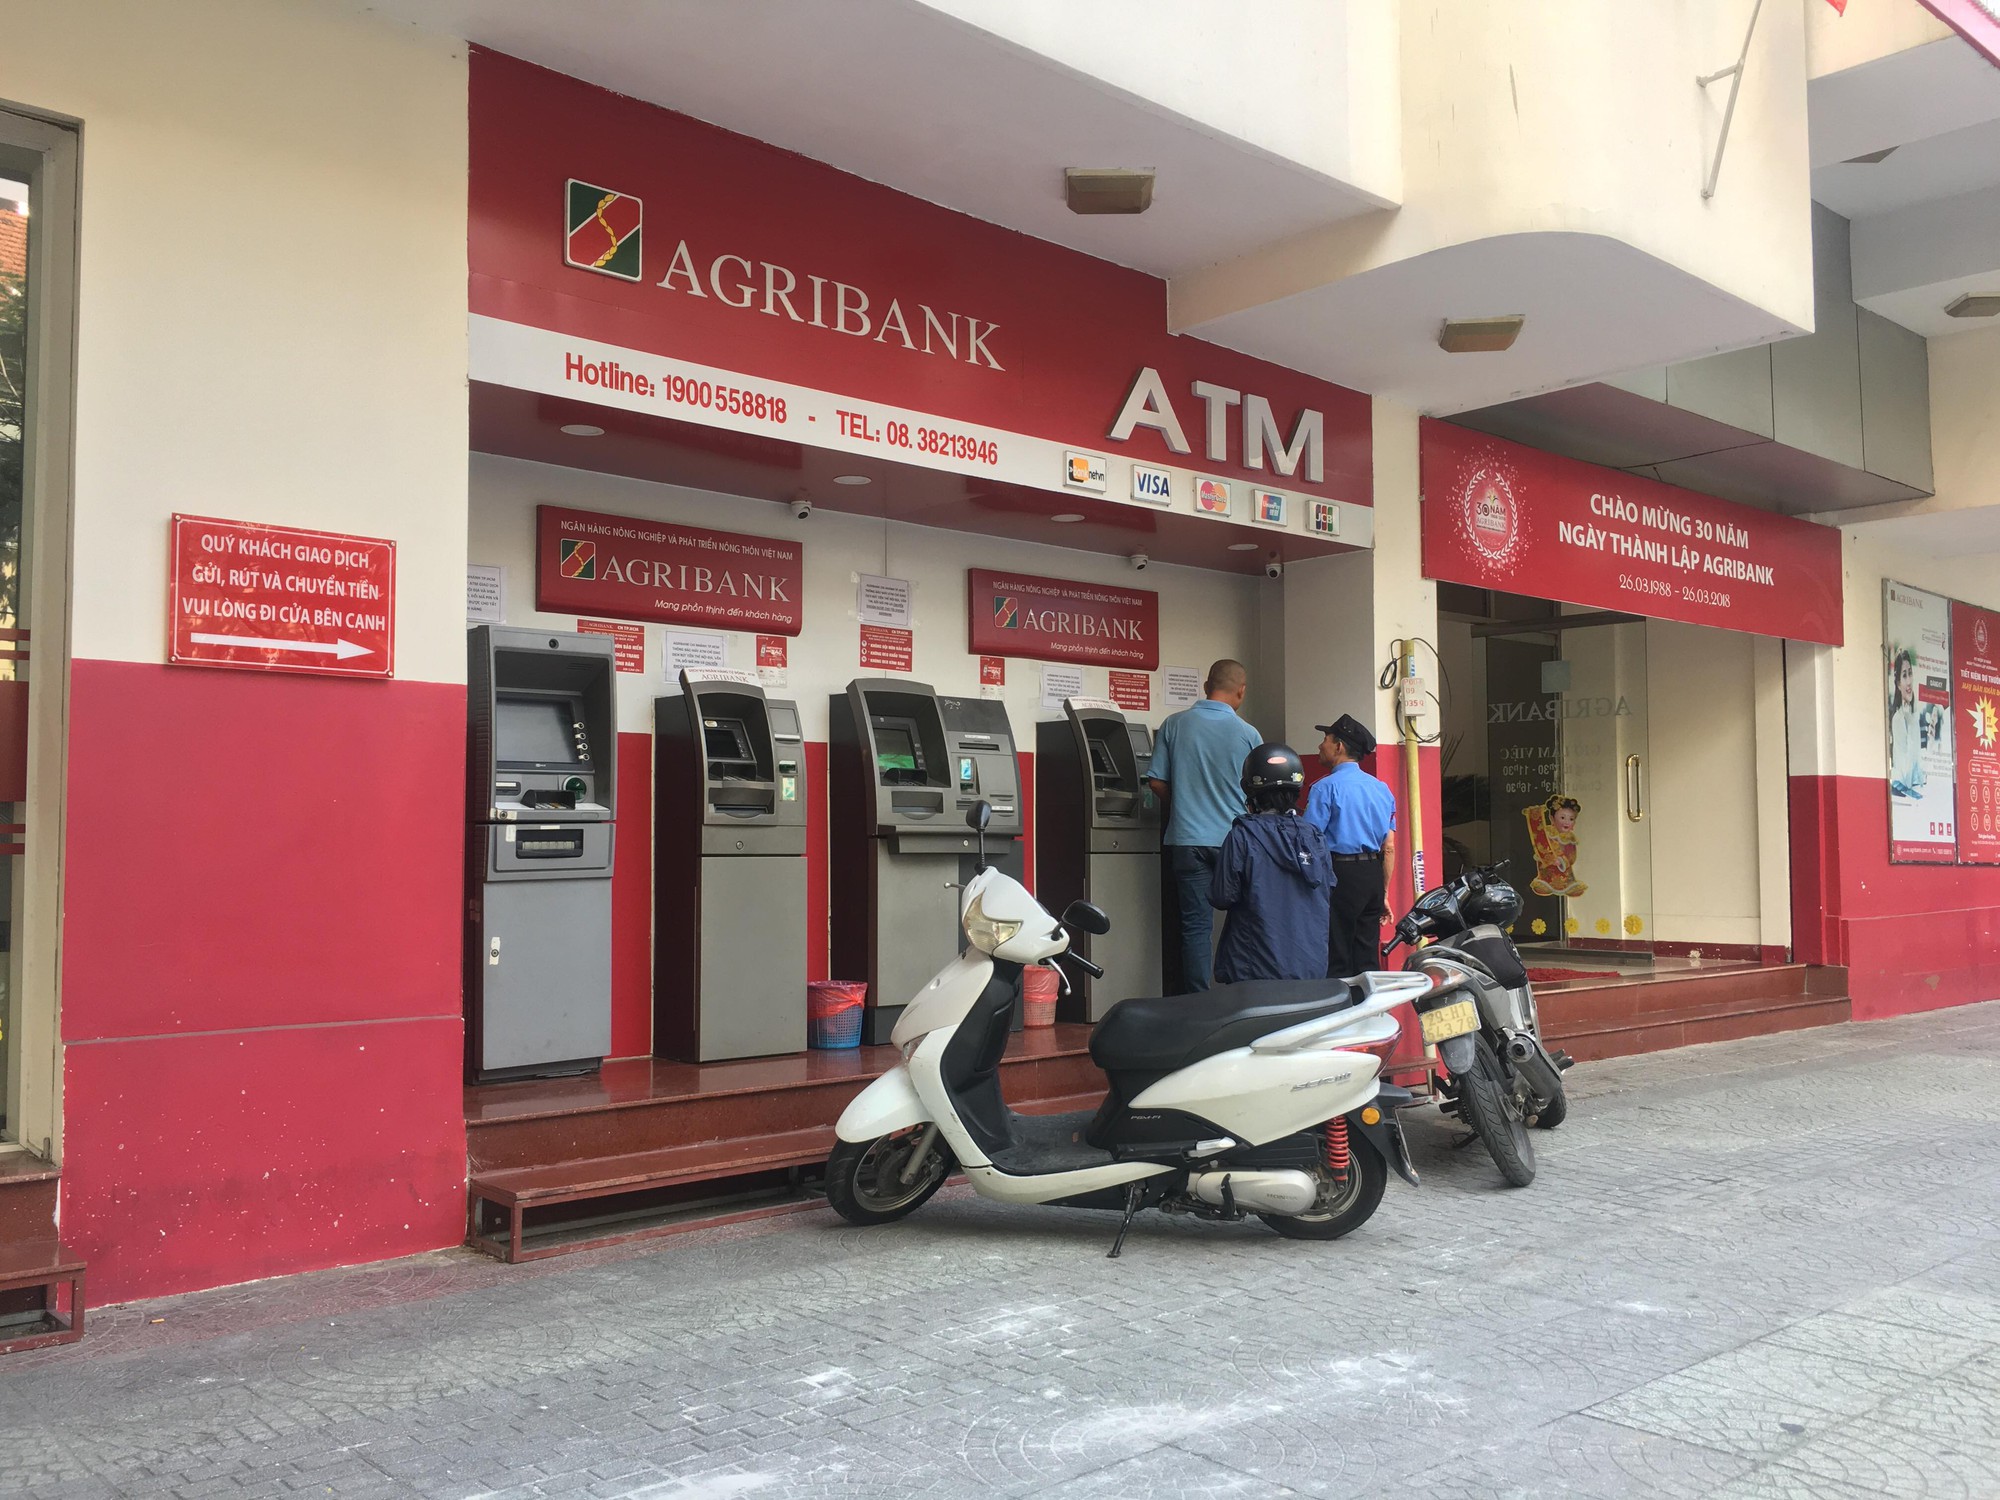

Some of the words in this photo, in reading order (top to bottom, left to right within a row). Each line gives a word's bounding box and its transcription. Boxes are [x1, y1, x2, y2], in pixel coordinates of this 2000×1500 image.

[657, 239, 1006, 371] AGRIBANK
[565, 352, 655, 398] Hotline:
[836, 409, 880, 443] TEL:
[1105, 366, 1324, 483] ATM
[1136, 472, 1170, 497] VISA
[1316, 512, 1332, 523] JCB
[1590, 493, 1638, 523] CHÀO
[1642, 505, 1692, 536] MỪNG
[1695, 519, 1713, 541] 30
[1716, 523, 1749, 549] NĂM
[201, 534, 235, 553] QUÝ
[239, 537, 291, 559] KHÁCH
[294, 545, 331, 564] GIAO
[335, 549, 369, 571] DỊCH
[560, 520, 585, 533] NGÂN
[587, 522, 611, 536] HÀNG
[612, 526, 636, 539] NÔNG
[638, 529, 666, 543] NGHIỆP
[668, 533, 677, 544] VÀ
[679, 534, 696, 547] PHÁT
[698, 537, 718, 550] TRIỂN
[719, 541, 740, 554] NÔNG
[742, 544, 760, 556] THÔN
[761, 547, 776, 560] VIỆT
[777, 550, 793, 561] NAM
[1559, 521, 1607, 551] NGÀY
[1610, 533, 1668, 564] THÀNH
[1672, 545, 1699, 574] LẬP
[1703, 553, 1774, 586] AGRIBANK
[229, 567, 259, 587] RÚT
[262, 571, 282, 591] VÀ
[285, 574, 345, 597] CHUYỂN
[348, 579, 379, 600] TIỀN
[601, 555, 792, 603] AGRIBANK
[1619, 573, 1672, 597] 26.03.1988
[1682, 586, 1731, 608] 26.03.2018
[182, 597, 209, 616] VUI
[213, 598, 256, 619] LÒNG
[260, 604, 275, 621] ĐI
[279, 602, 310, 625] CỬA
[314, 606, 342, 627] BÊN
[345, 612, 385, 634] CẠNH
[654, 599, 680, 612] Mang
[706, 605, 725, 616] thịnh
[727, 606, 743, 618] đến
[745, 608, 770, 620] khách
[772, 612, 793, 624] hàng
[1023, 608, 1144, 641] AGRIBANK
[1426, 1003, 1466, 1027] 29-H1
